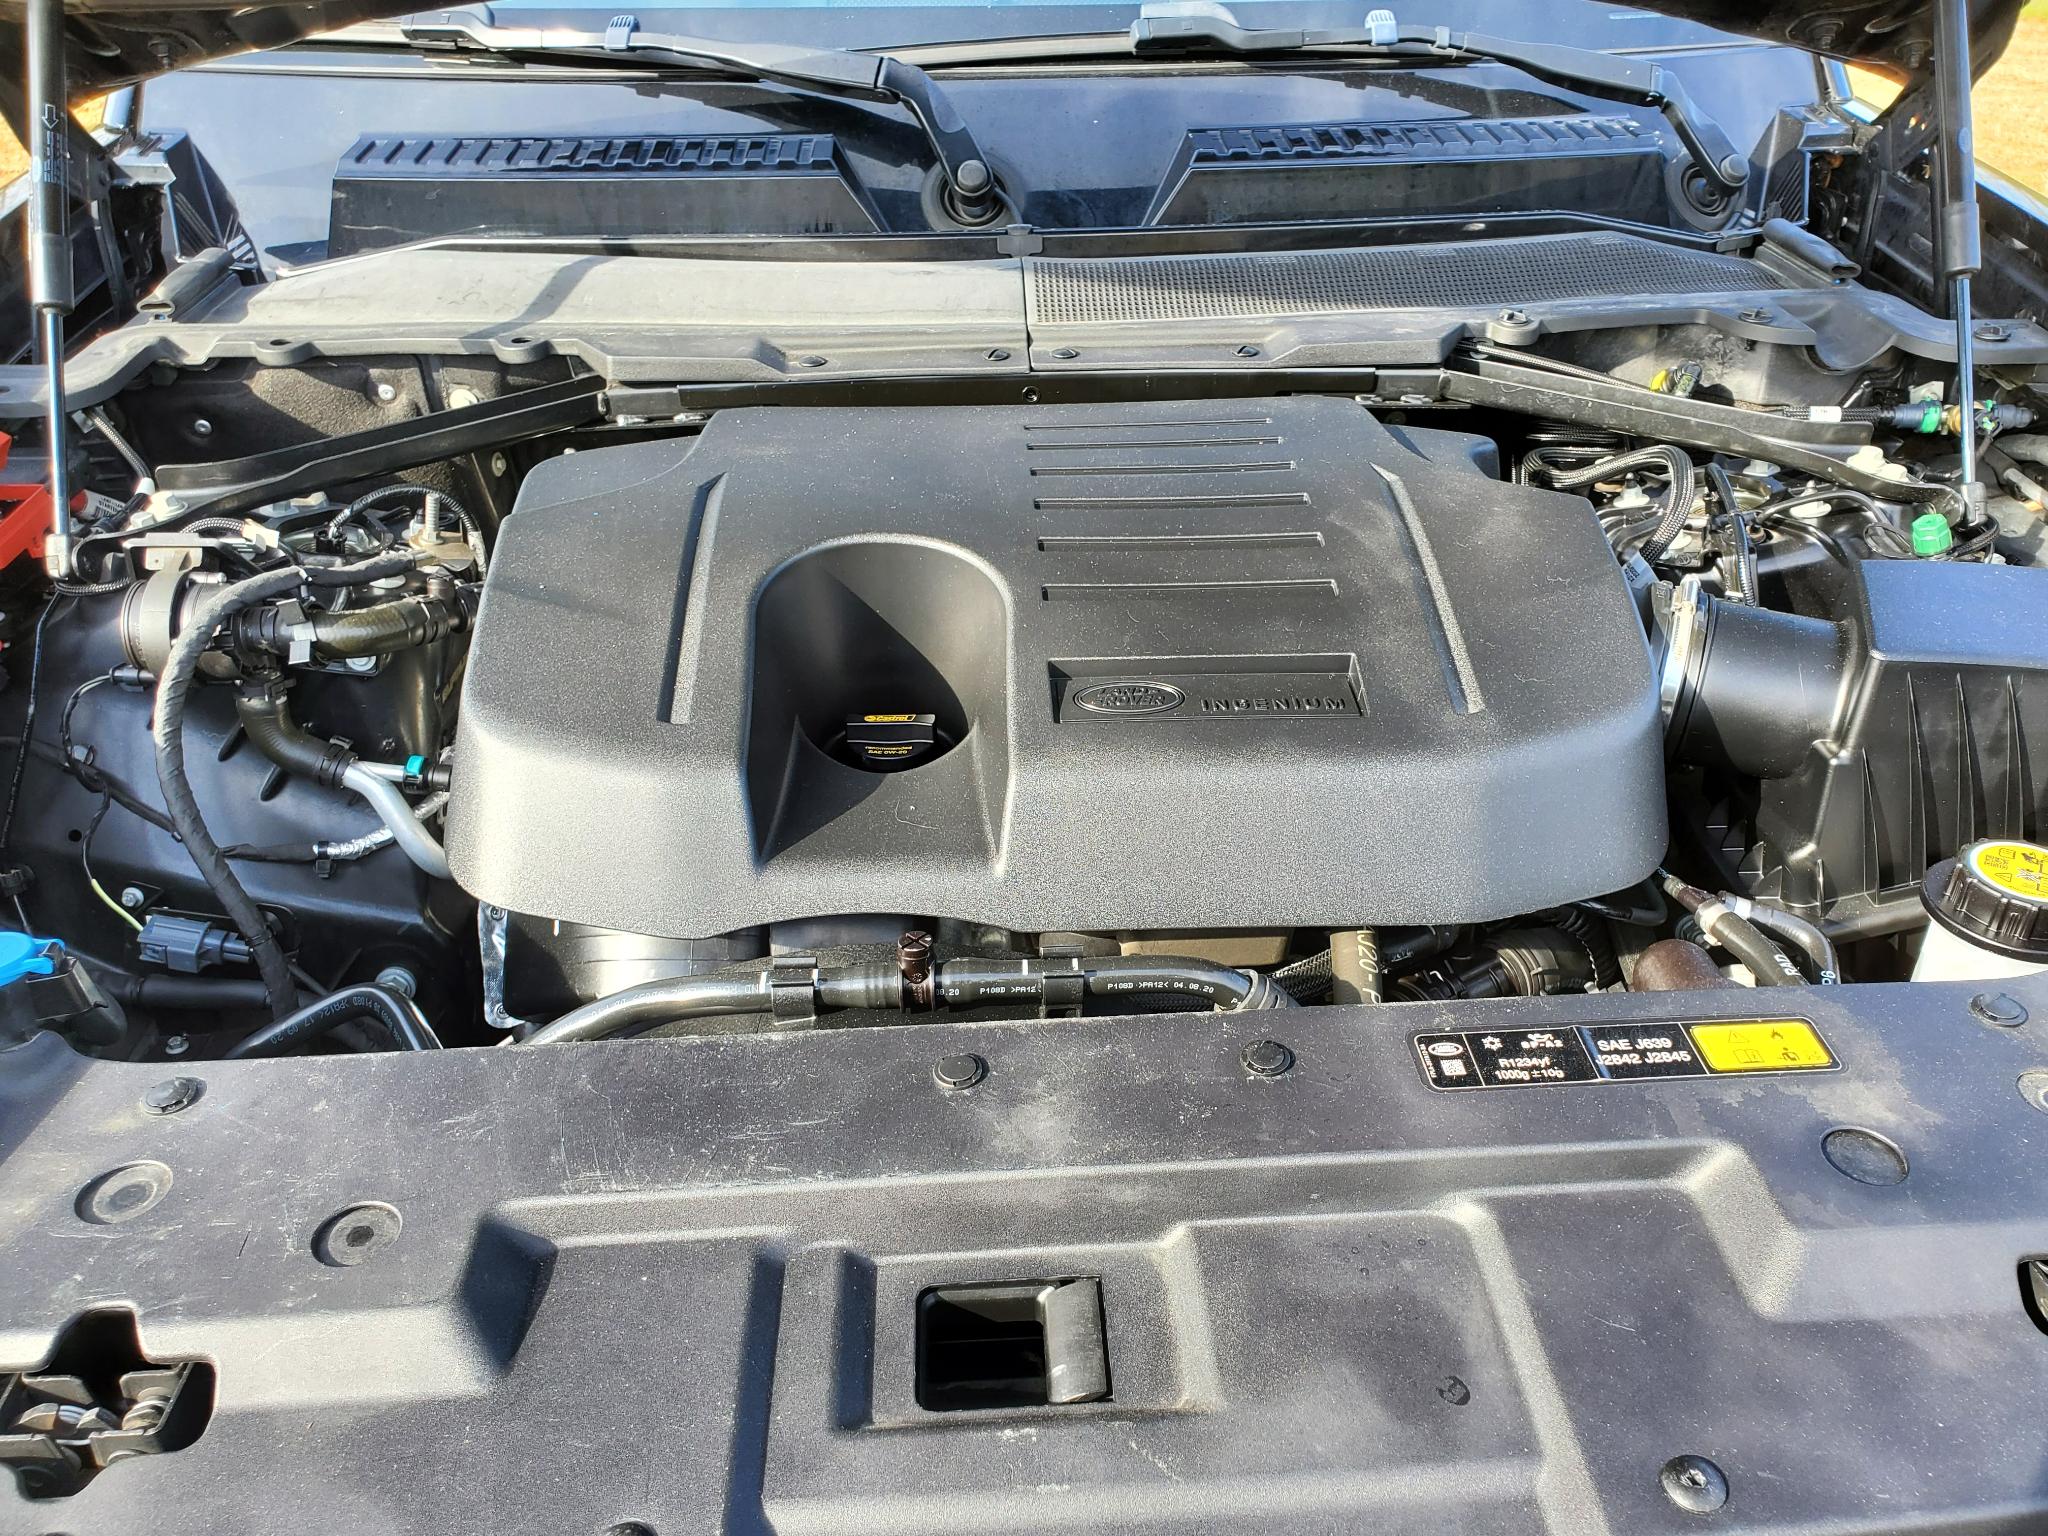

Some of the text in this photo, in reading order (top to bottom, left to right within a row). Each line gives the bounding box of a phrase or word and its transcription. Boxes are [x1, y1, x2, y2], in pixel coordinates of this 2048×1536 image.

[1200, 697, 1346, 712] INGENIUM
[1773, 953, 1801, 976] RAD
[1597, 1037, 1673, 1051] SAE J639
[1498, 1056, 1550, 1068] R1234yf
[1595, 1050, 1691, 1066] J2842 J2845
[1495, 1069, 1531, 1080] 1000g
